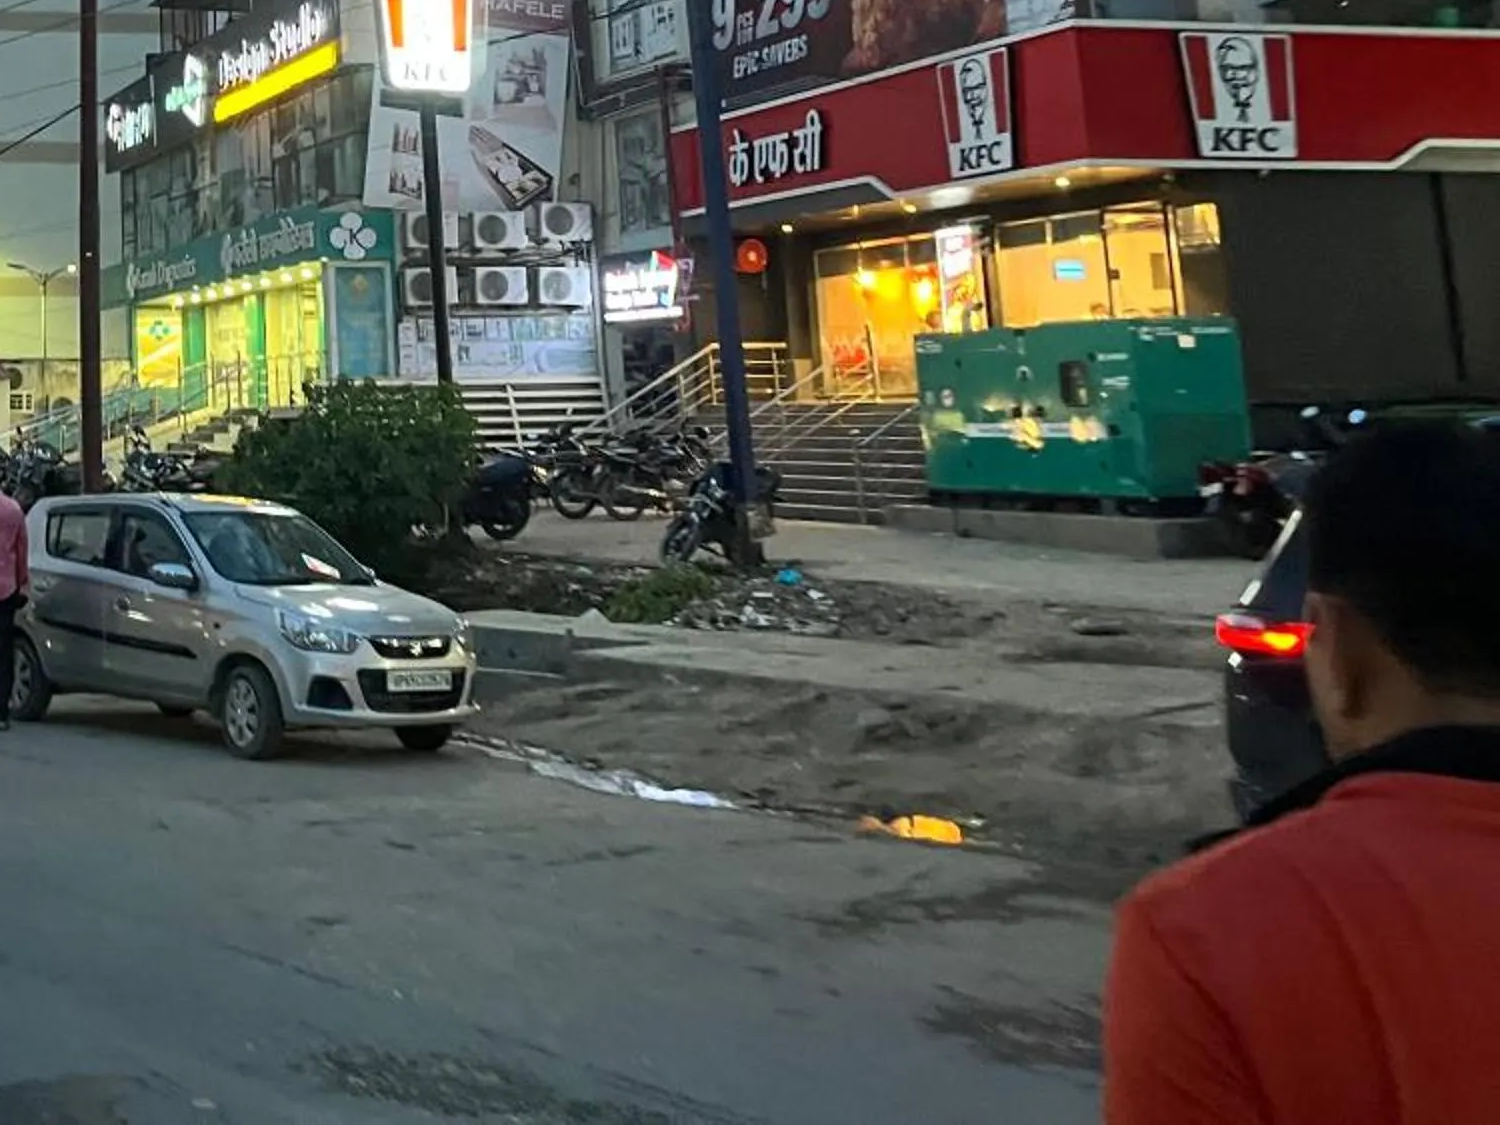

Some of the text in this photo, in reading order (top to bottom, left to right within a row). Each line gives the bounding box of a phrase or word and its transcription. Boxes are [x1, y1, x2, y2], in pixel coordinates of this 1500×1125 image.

[733, 34, 808, 78] EPIC SAVERS
[959, 140, 1003, 170] KFC
[1211, 127, 1282, 153] KFC
